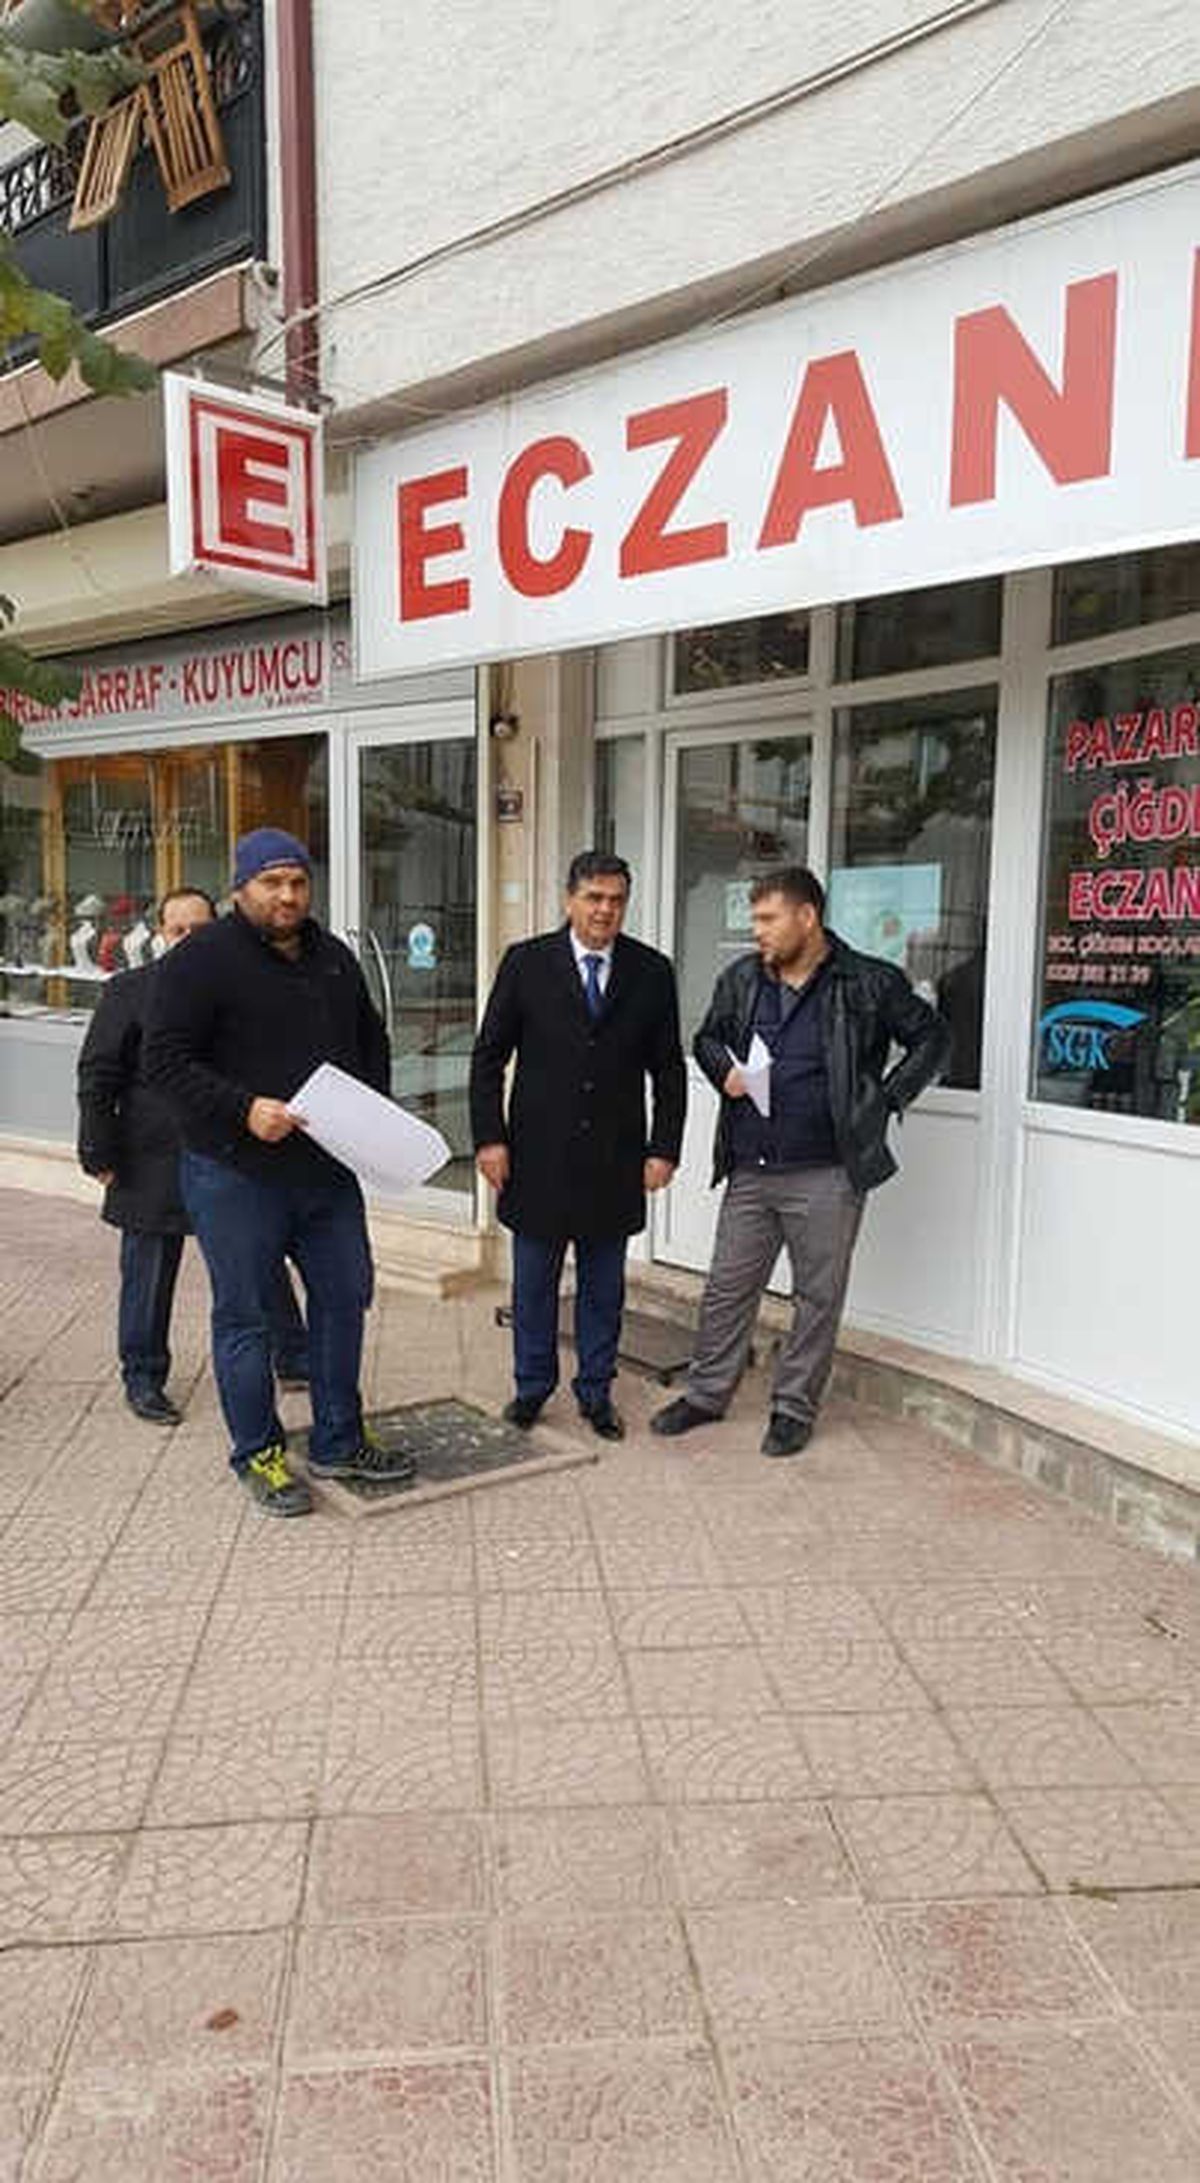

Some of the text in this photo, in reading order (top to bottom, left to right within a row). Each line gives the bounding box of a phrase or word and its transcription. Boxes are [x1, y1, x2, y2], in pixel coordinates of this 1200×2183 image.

[396, 245, 1200, 622] ECZAN
[217, 427, 294, 557] E
[182, 641, 323, 704] KUYUMCU
[1066, 702, 1200, 771] PAZAR
[1048, 1025, 1109, 1070] SGK
